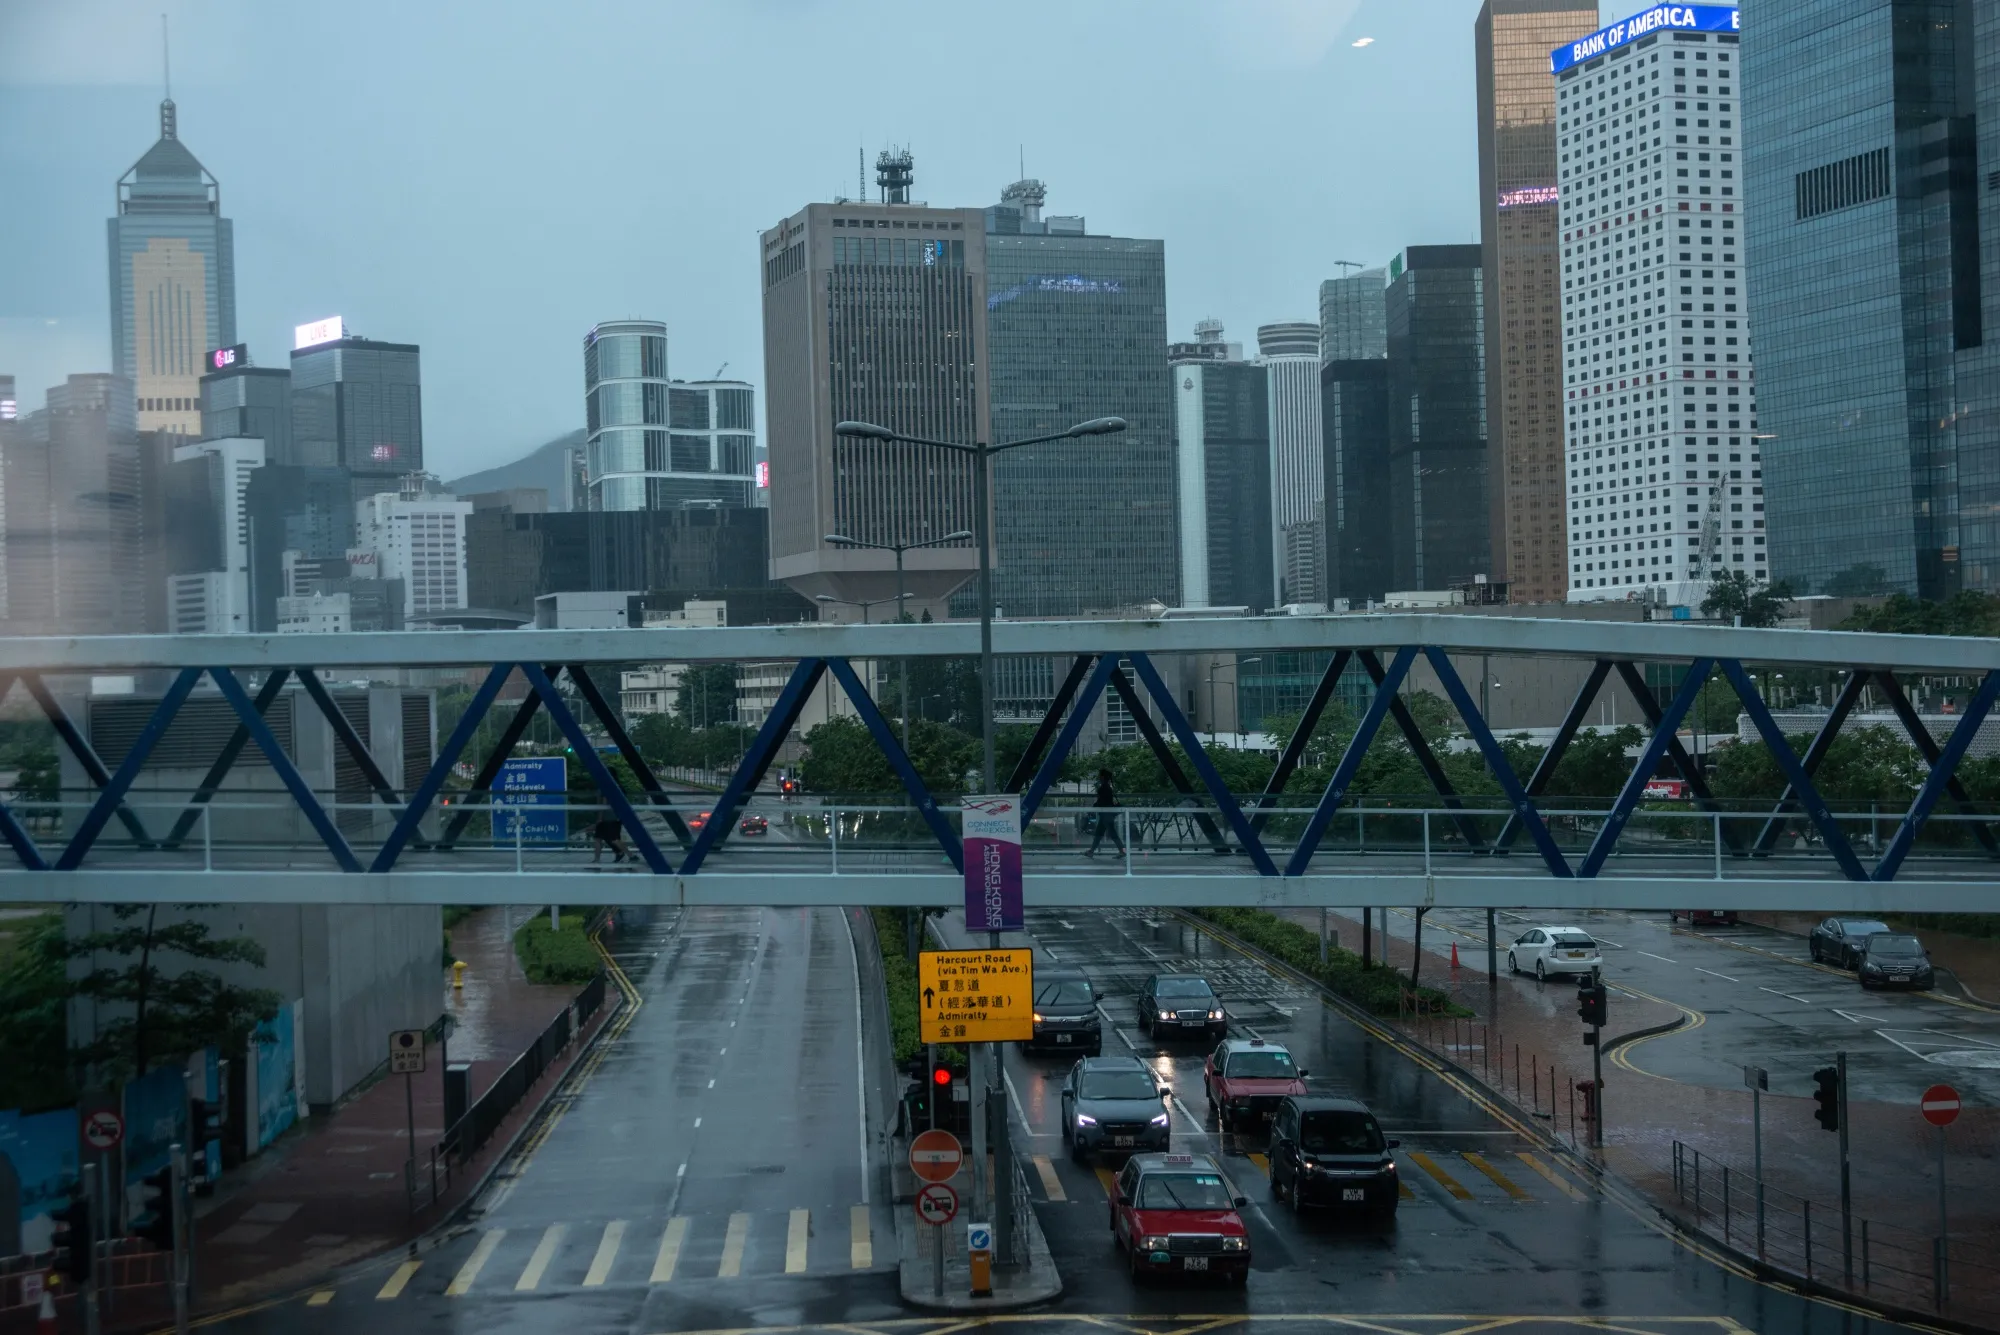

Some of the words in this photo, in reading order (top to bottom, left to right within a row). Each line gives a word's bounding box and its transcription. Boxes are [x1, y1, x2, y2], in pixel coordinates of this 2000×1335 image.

[1573, 32, 1606, 62] BANK
[1608, 24, 1625, 47] OF
[1627, 7, 1696, 39] AMERICA
[504, 762, 543, 770] Admiralty
[967, 820, 1009, 828] CONNECT
[989, 826, 1017, 834] EXCEL
[990, 844, 1001, 885] HONG
[992, 888, 1002, 928] KONG
[985, 906, 993, 927] CITY
[936, 955, 982, 964] Harcourt
[985, 954, 1011, 963] Road
[938, 967, 957, 976] (via
[960, 965, 978, 974] Tim
[981, 965, 997, 974] Wa
[1001, 964, 1028, 975] Ave.)
[938, 1011, 988, 1021] Admiralty
[939, 1024, 967, 1038] 金鐘
